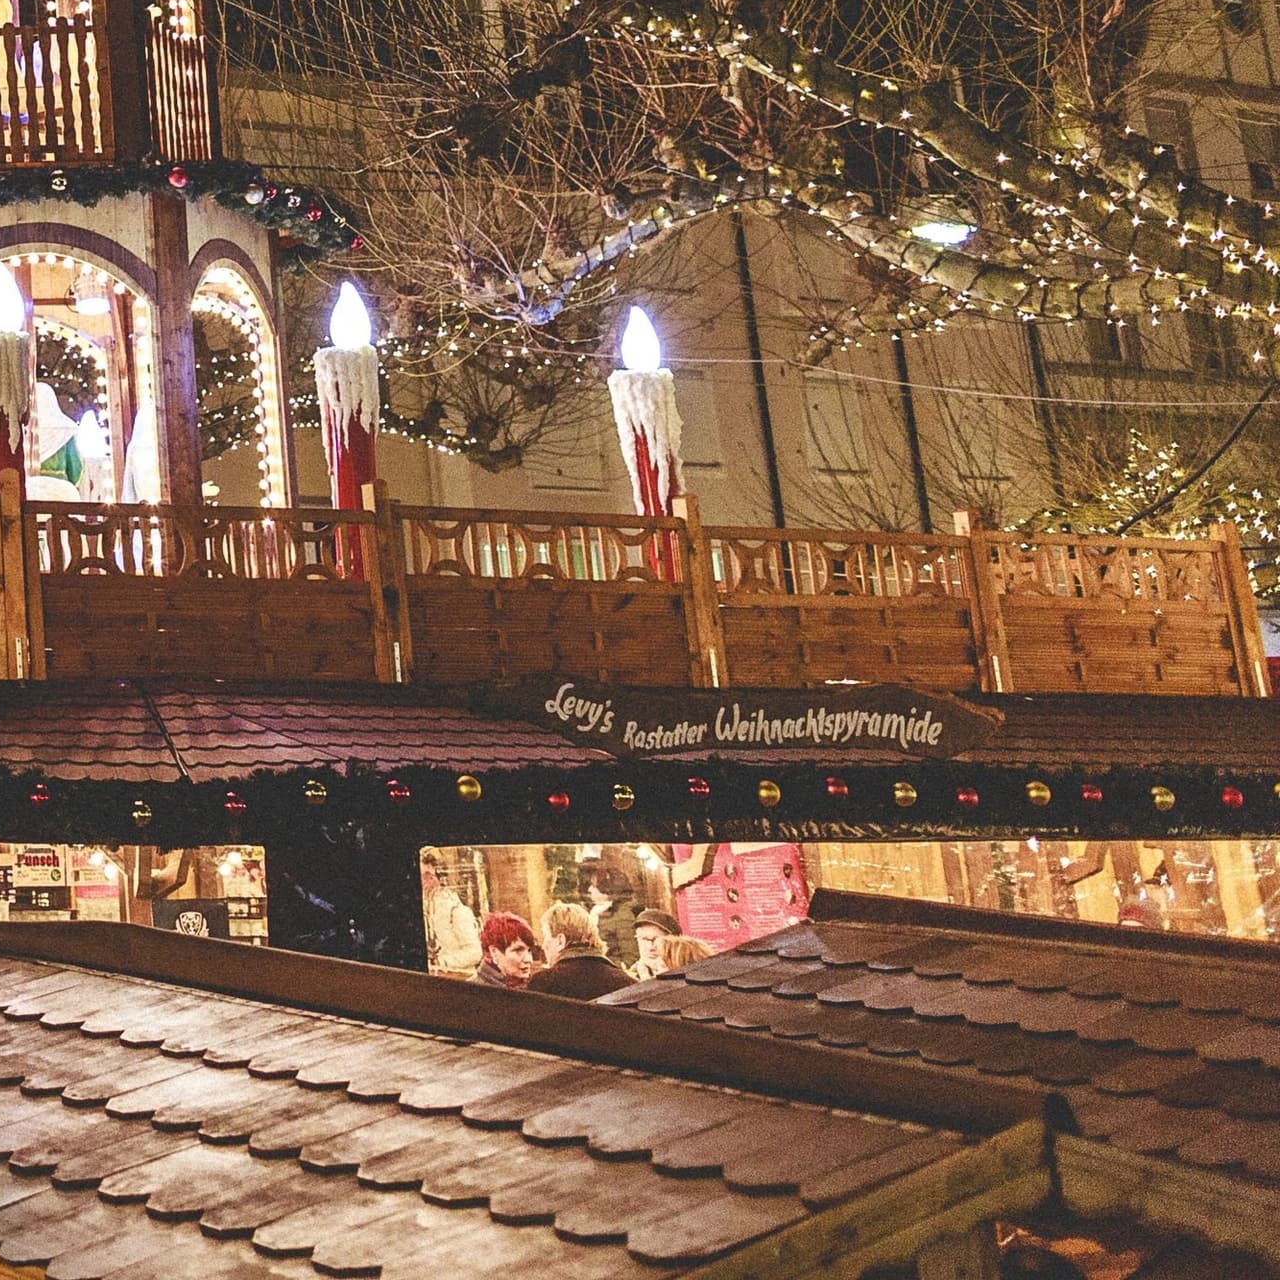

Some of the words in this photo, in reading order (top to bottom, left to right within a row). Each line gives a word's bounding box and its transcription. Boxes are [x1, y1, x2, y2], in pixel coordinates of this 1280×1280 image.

[545, 682, 615, 734] Levy's
[623, 720, 708, 750] Rastatter
[715, 702, 942, 749] Weihnachtspyramide
